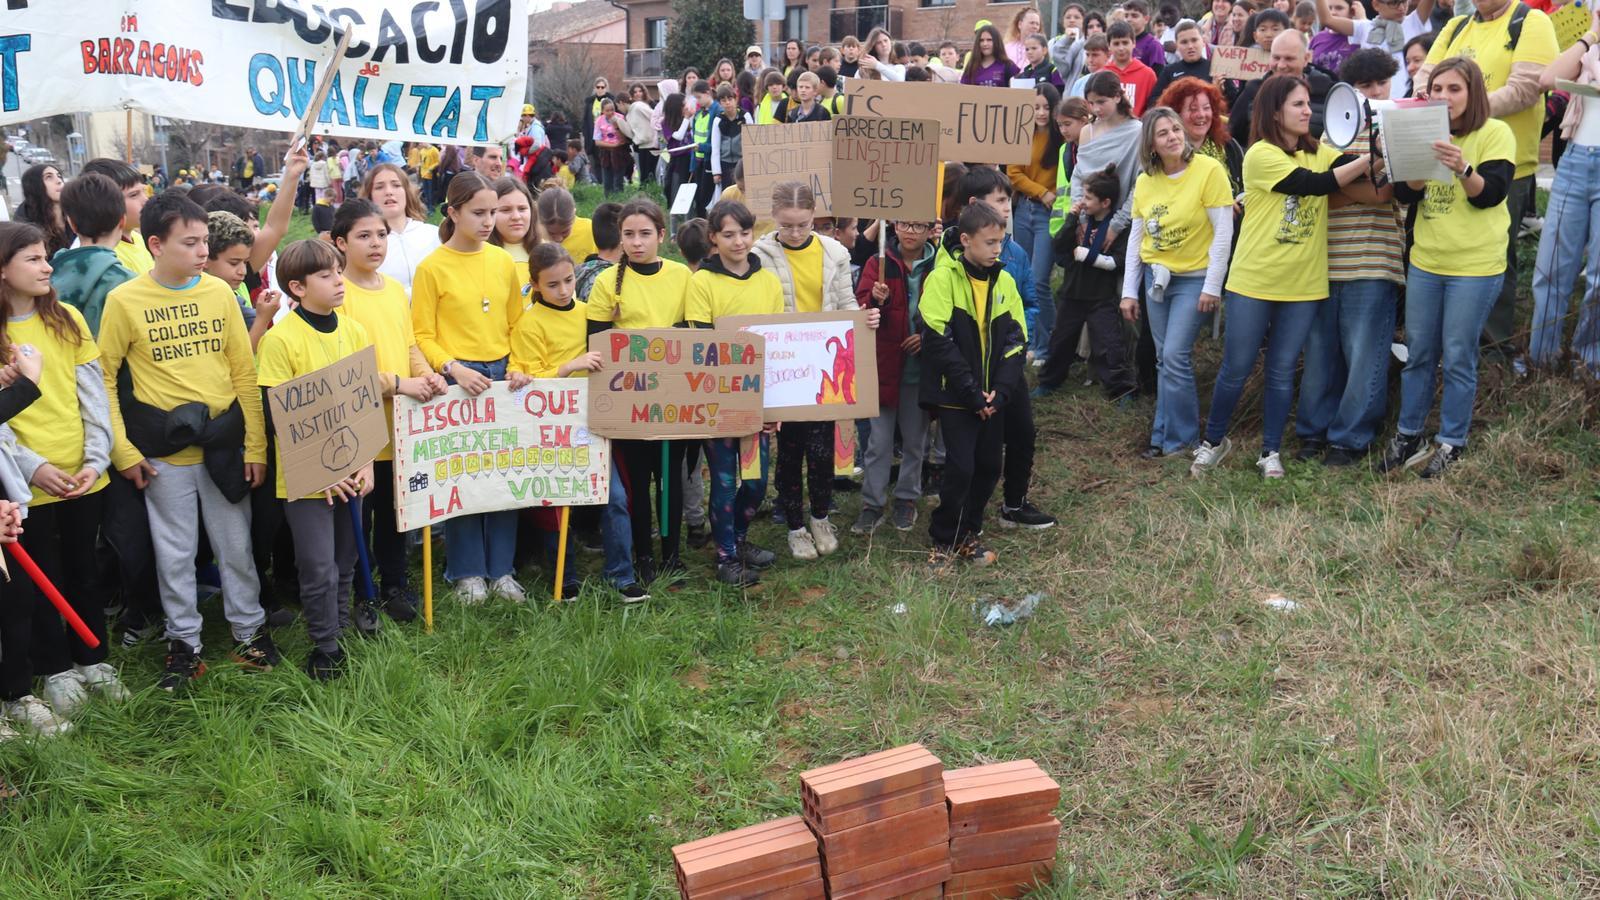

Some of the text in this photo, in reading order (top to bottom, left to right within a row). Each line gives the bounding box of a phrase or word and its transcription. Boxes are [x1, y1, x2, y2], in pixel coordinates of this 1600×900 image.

[80, 37, 204, 86] BARRACONS
[248, 52, 506, 141] QUALITAT
[834, 117, 924, 141] ARREGLEM
[957, 102, 1035, 145] FUTUR
[836, 137, 937, 167] L'INSTITUT
[867, 160, 890, 183] DE
[853, 187, 904, 209] SILS
[144, 303, 199, 324] UNITED
[149, 321, 208, 342] COLORS
[610, 333, 681, 365] PROU
[274, 360, 363, 413] VOLEM UN
[609, 370, 760, 393] CONS VOLEM
[289, 374, 380, 444] INSTITUT JA!
[524, 389, 579, 418] QUE
[631, 402, 719, 427] MAONS!
[413, 424, 572, 463] MEREIXEM EN
[429, 473, 597, 519] LA VOLEM!
